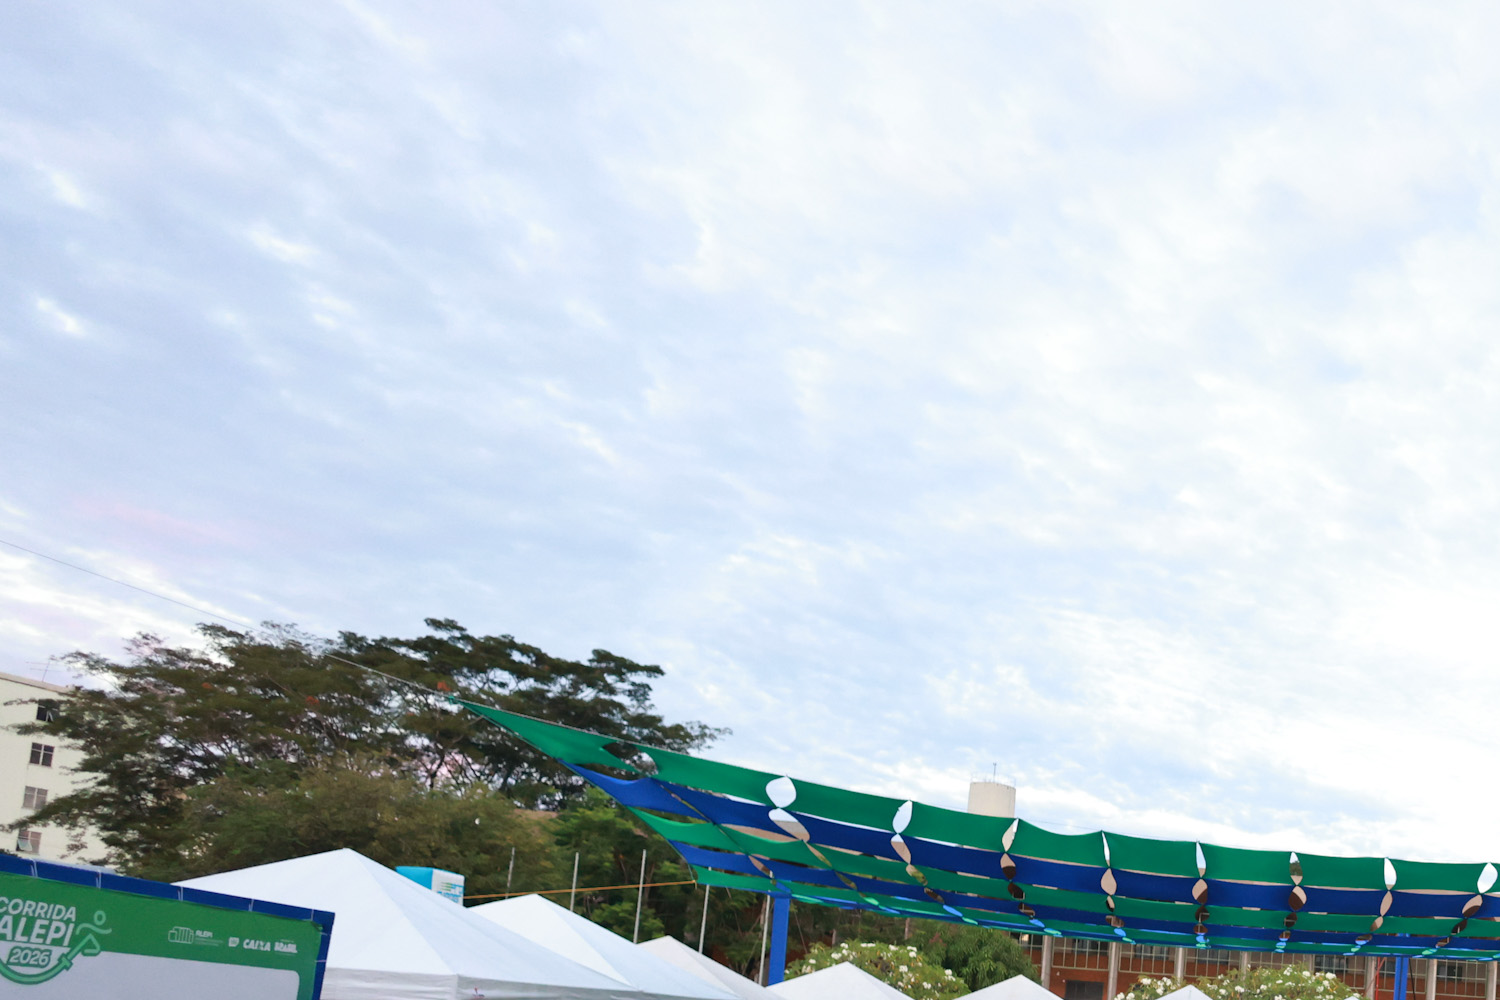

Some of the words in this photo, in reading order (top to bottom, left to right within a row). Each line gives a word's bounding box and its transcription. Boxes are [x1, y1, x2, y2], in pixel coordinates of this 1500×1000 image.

[0, 915, 75, 946] ALEPI
[243, 939, 271, 951] CAIXA
[9, 948, 50, 966] 2026
